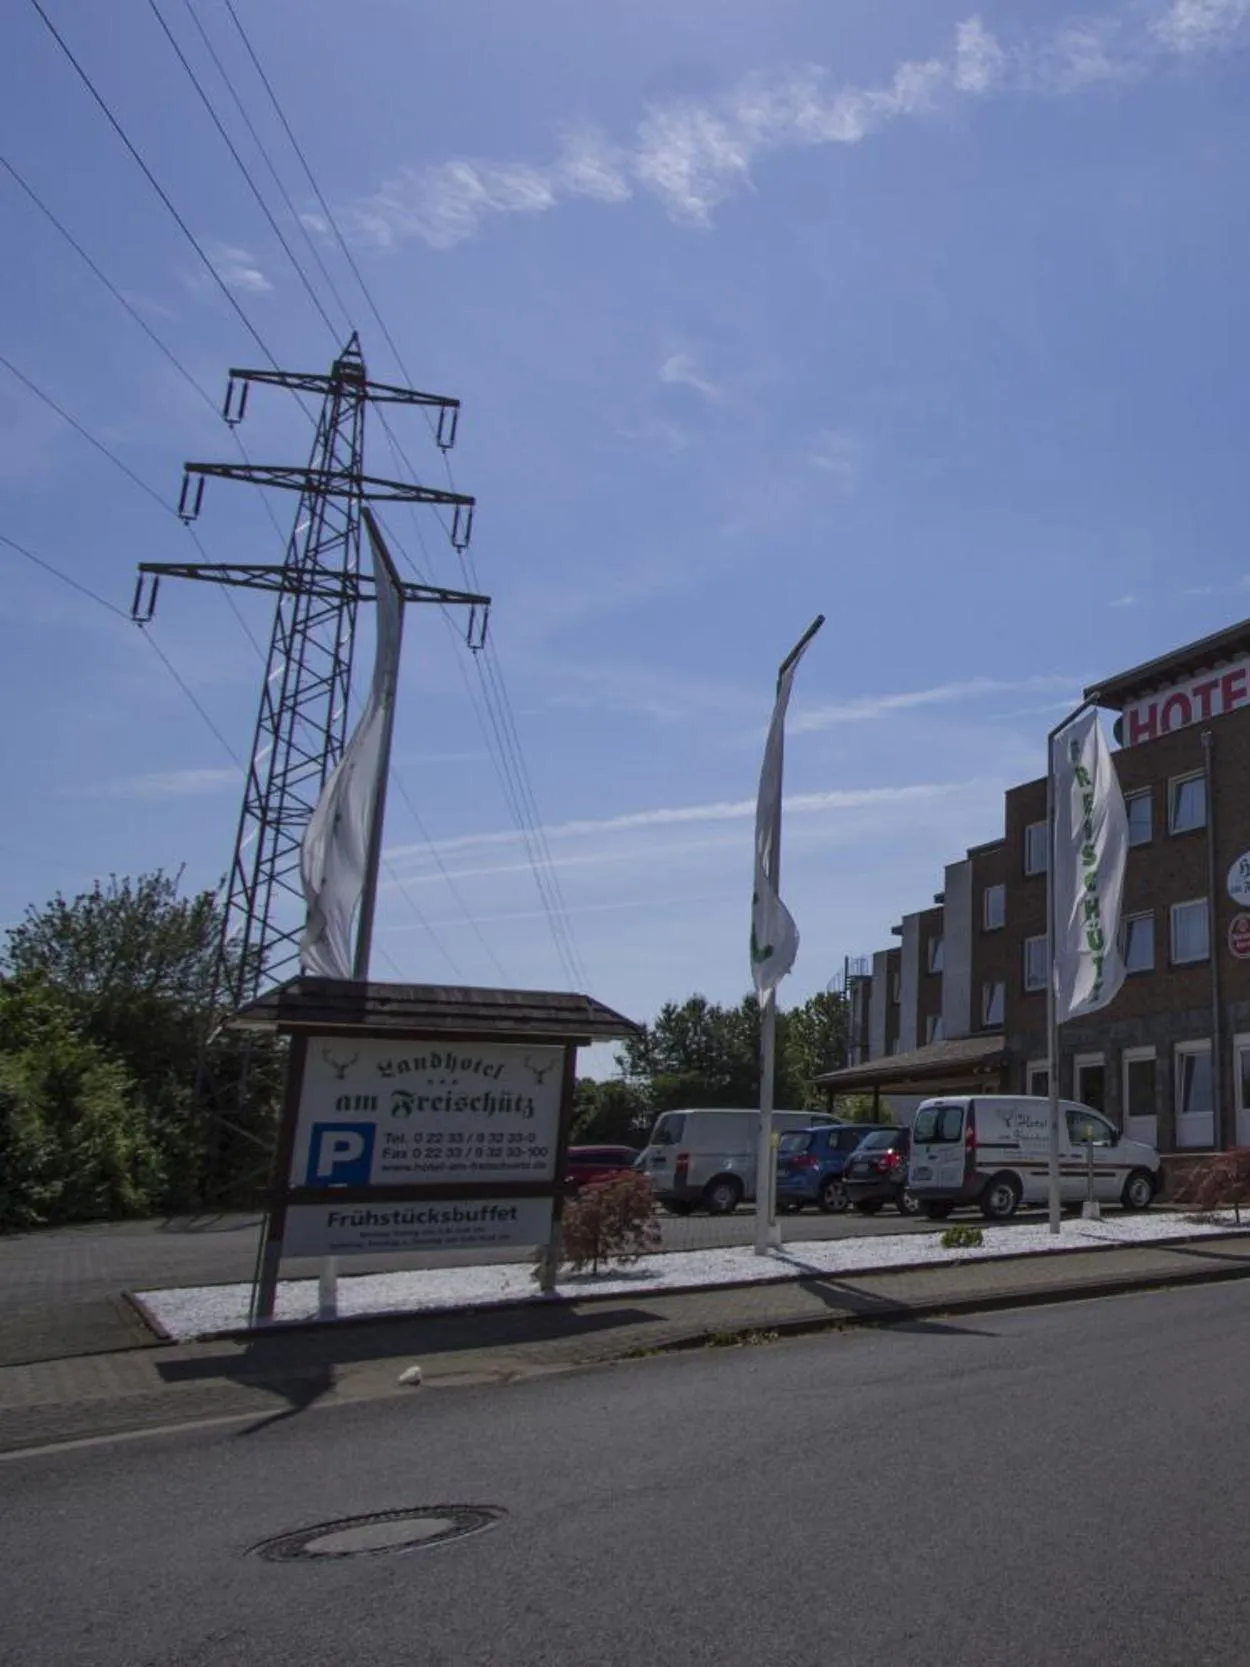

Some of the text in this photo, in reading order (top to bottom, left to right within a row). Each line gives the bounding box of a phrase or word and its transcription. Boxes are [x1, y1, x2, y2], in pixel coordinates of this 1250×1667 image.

[376, 1050, 505, 1080] Landhotel
[335, 1089, 535, 1118] am Freischütz
[383, 1132, 408, 1144] Tel.
[316, 1131, 366, 1177] P
[382, 1147, 408, 1159] Fax
[327, 1204, 518, 1228] Frühstücksbuffet
